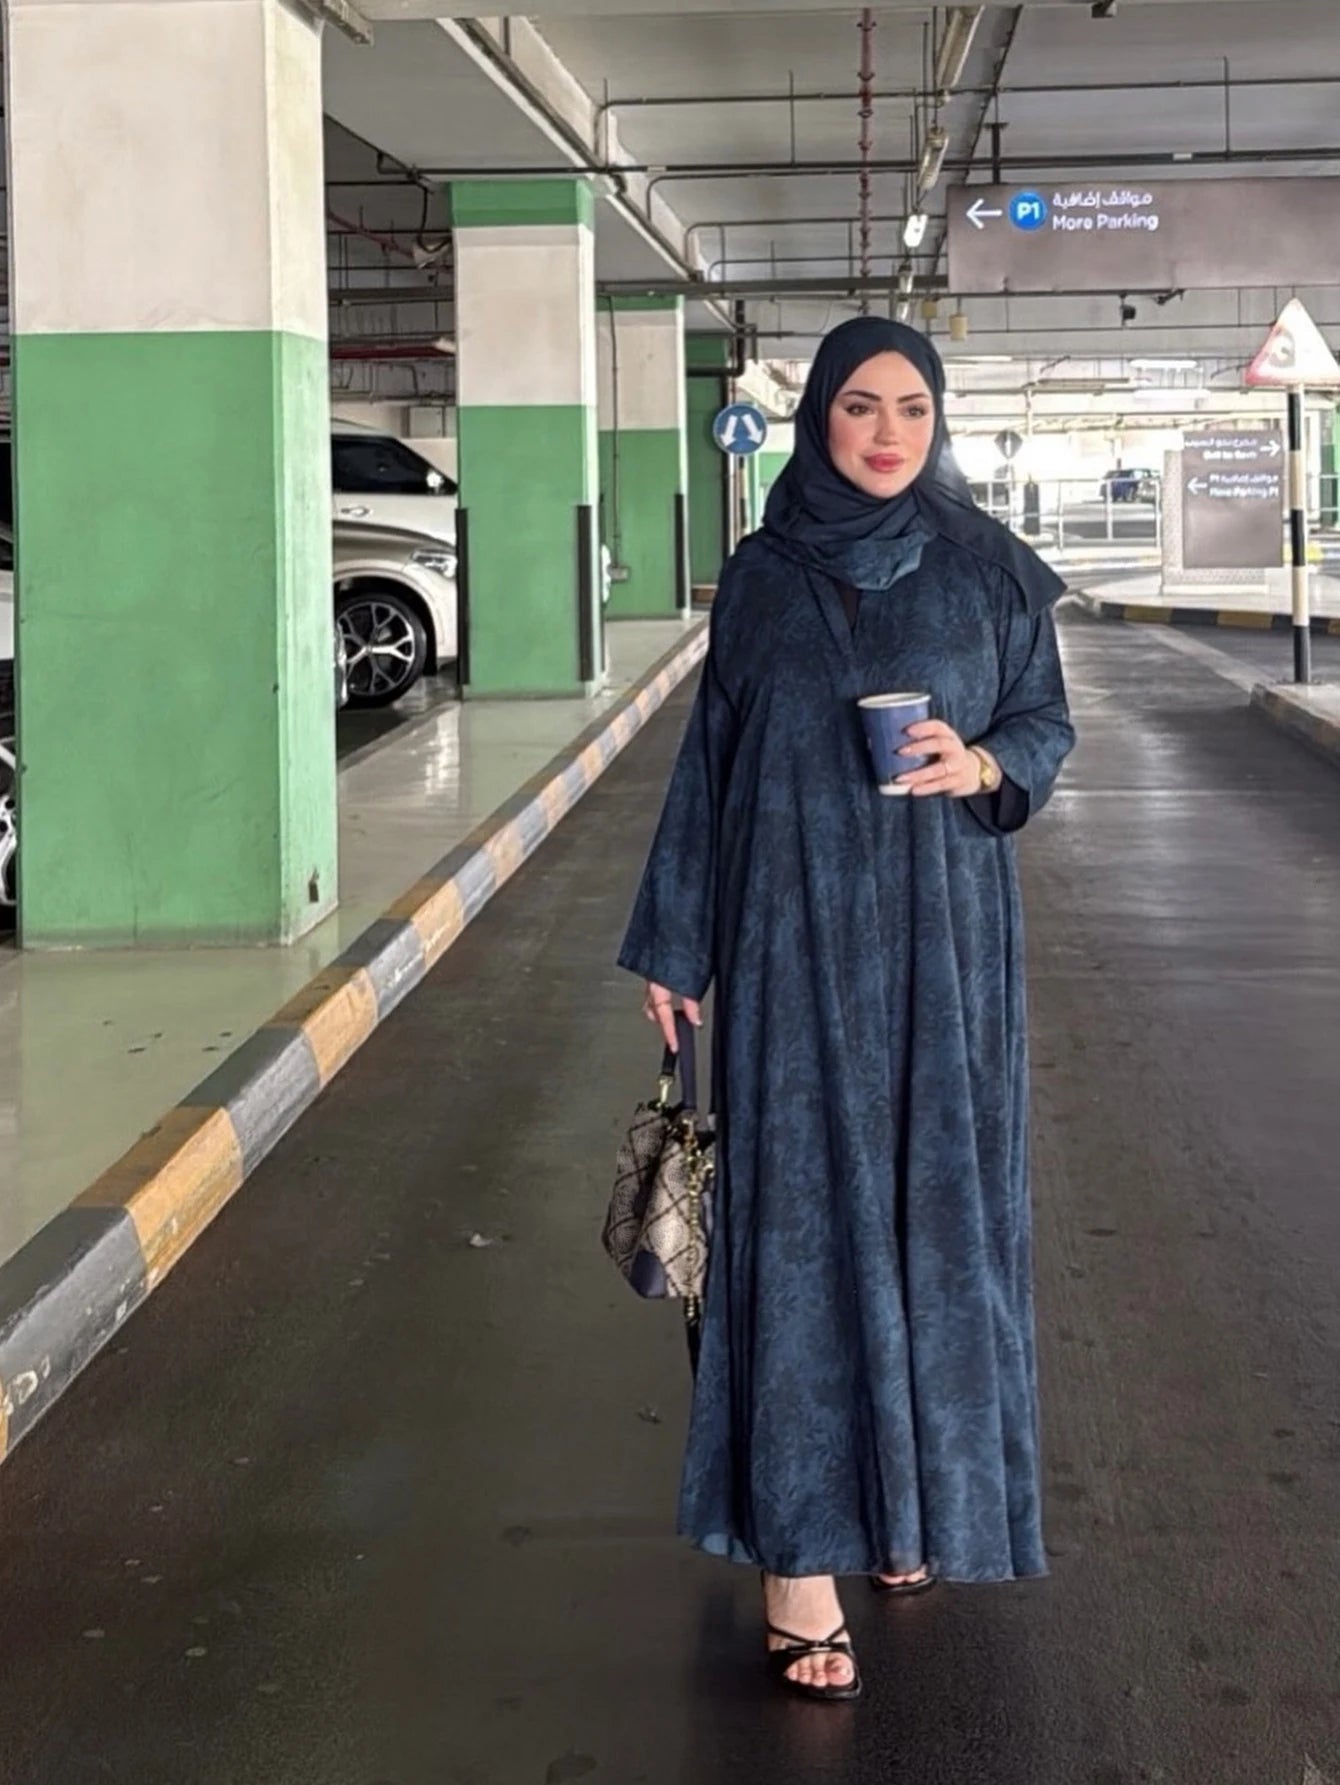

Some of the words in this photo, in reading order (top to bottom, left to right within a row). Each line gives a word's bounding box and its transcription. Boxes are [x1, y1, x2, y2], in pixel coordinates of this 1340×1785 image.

[1053, 193, 1100, 209] إضافية
[1102, 191, 1153, 208] مواقف
[1017, 202, 1040, 220] P1
[1053, 215, 1091, 231] More
[1097, 214, 1159, 231] Parking
